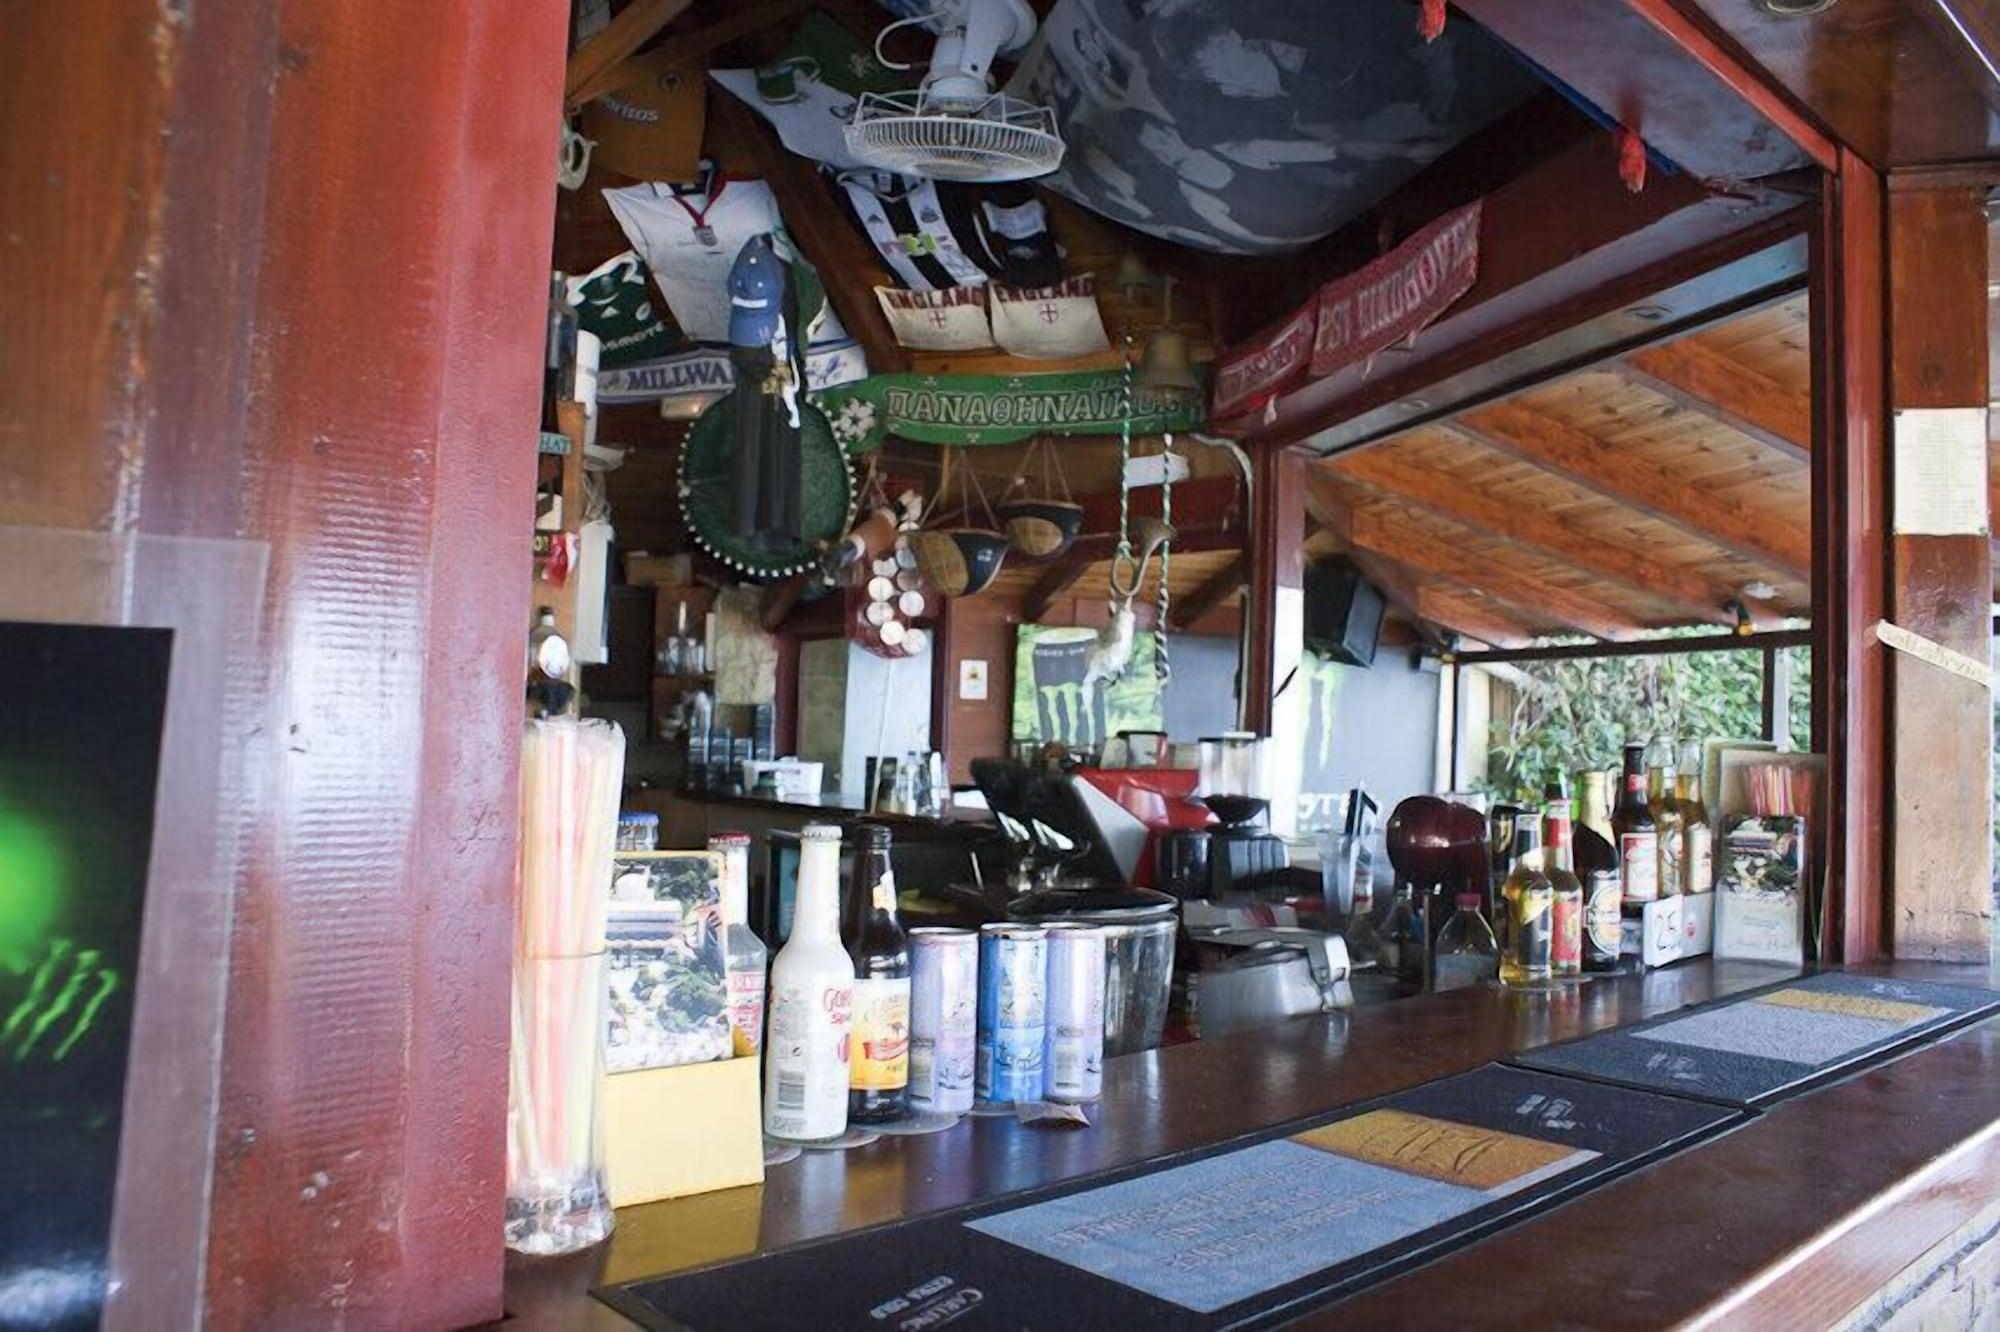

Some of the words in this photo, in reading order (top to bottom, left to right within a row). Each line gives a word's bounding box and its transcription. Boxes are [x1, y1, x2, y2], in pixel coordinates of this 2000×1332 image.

[887, 286, 985, 309] ENGLAND
[996, 277, 1094, 303] ENGLAND
[626, 361, 728, 392] MILLWA
